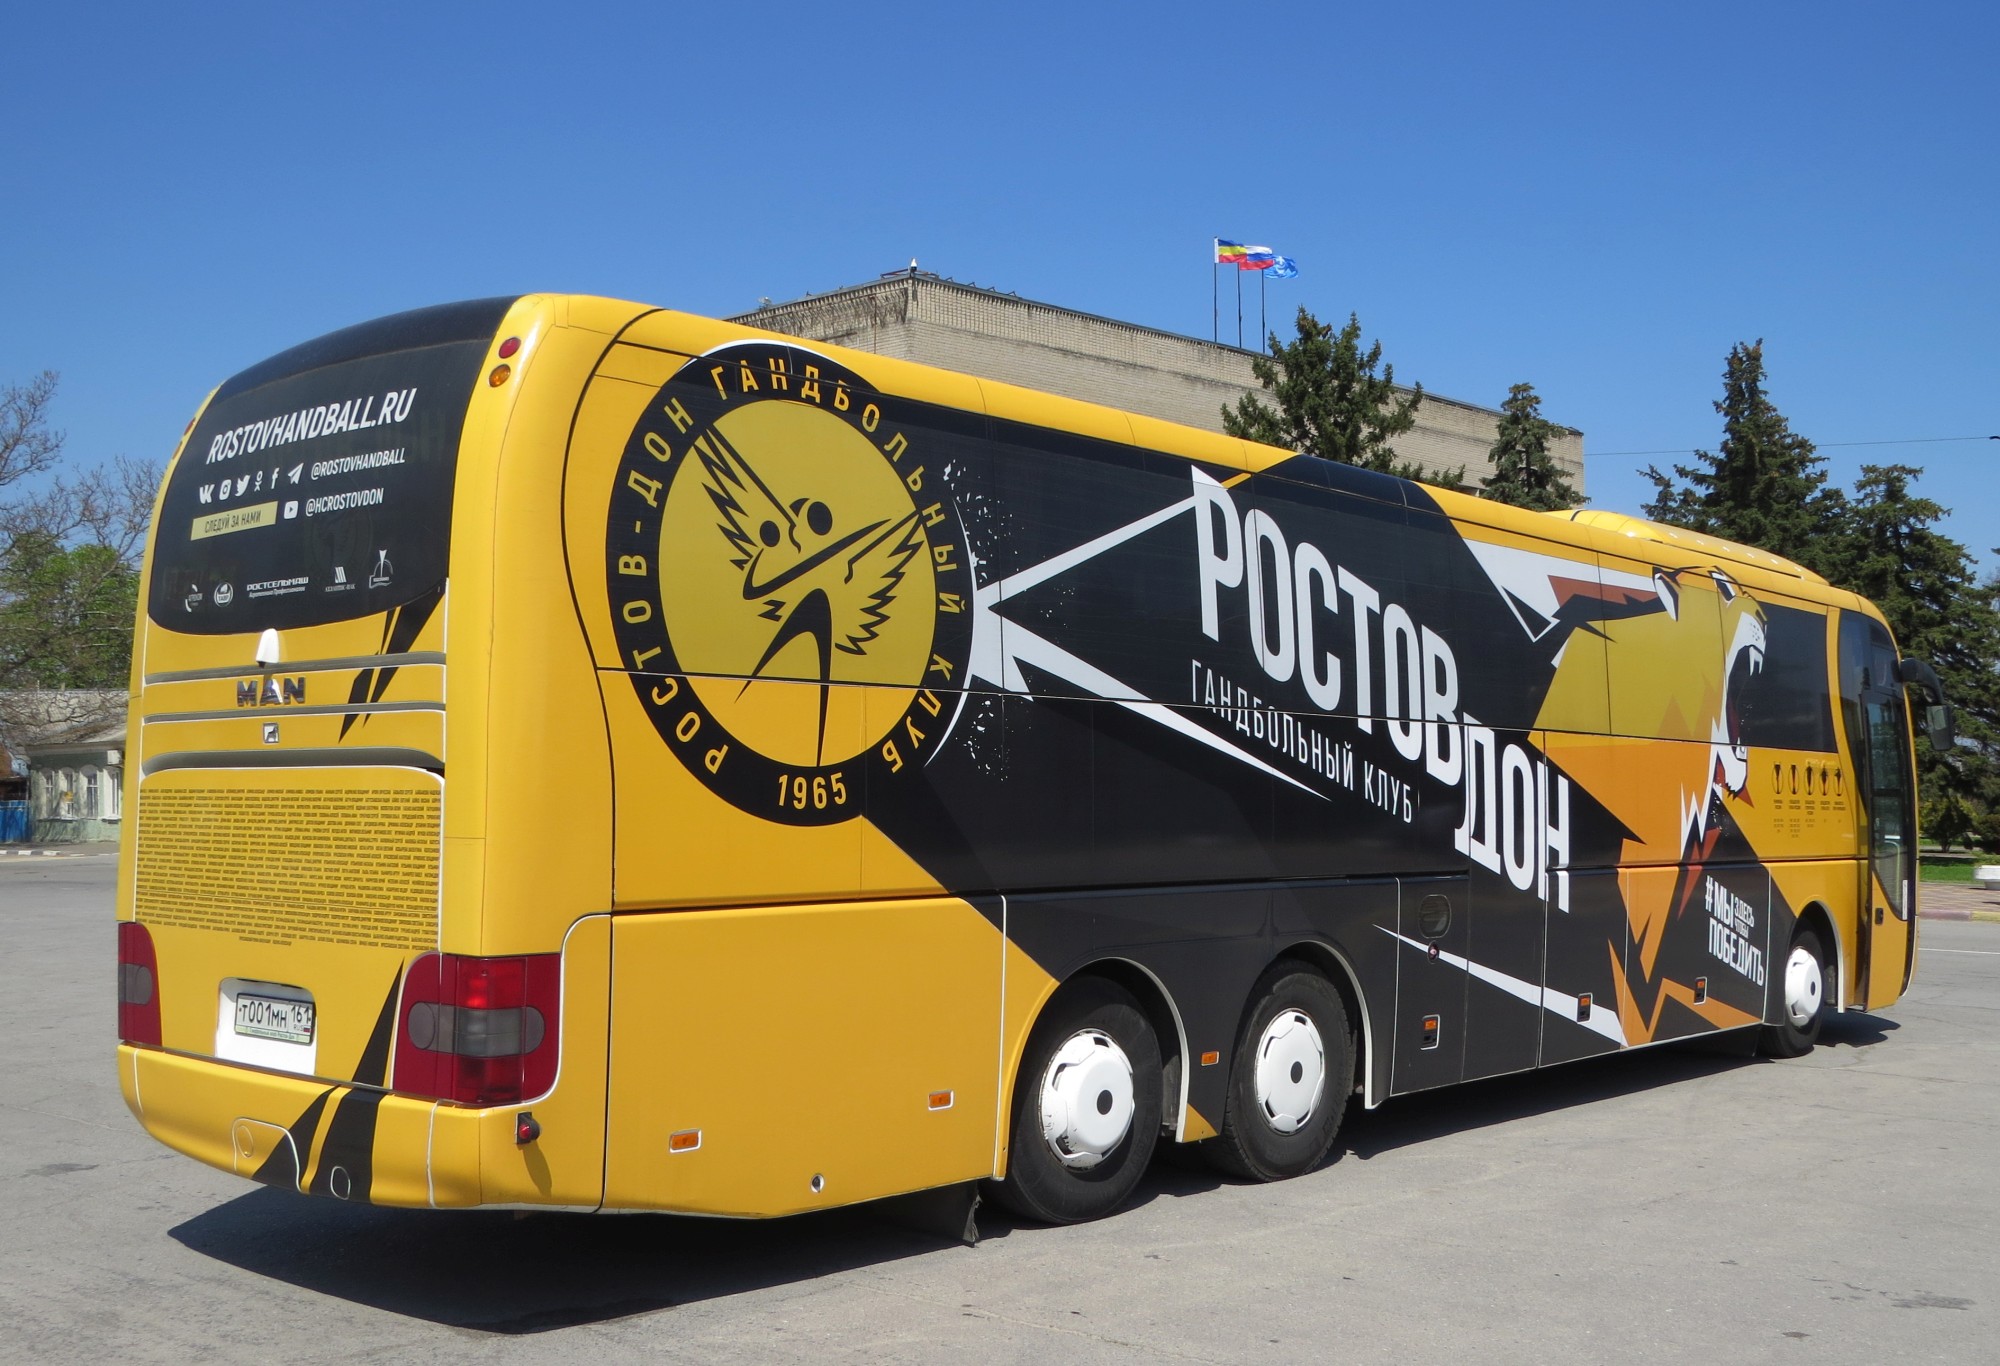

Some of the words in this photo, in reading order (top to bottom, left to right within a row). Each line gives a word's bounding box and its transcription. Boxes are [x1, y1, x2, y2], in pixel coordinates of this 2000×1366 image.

[206, 388, 418, 465] ROSTOVHANDBALL.RU
[311, 447, 405, 481] @ROSTOVHANDBALL
[204, 514, 230, 534] СЛЕДУЙ
[230, 514, 240, 529] ЗА
[240, 510, 262, 526] НАМИ
[305, 487, 385, 517] @HCROSTOVDON
[710, 357, 966, 615] ГАНДБОЛЬНЫЙ
[882, 653, 955, 774] КЛУБ
[1191, 464, 1462, 786] РОСТОВ
[236, 676, 306, 708] MAN
[1191, 658, 1355, 791] ГАНДБОЛЬНЫЙ
[1364, 760, 1413, 824] КЛУБ
[778, 772, 847, 810] 1965
[1454, 711, 1570, 914] ДОН
[1705, 875, 1734, 929] #МЫ
[1708, 916, 1765, 987] ПОБЕДИТЬ
